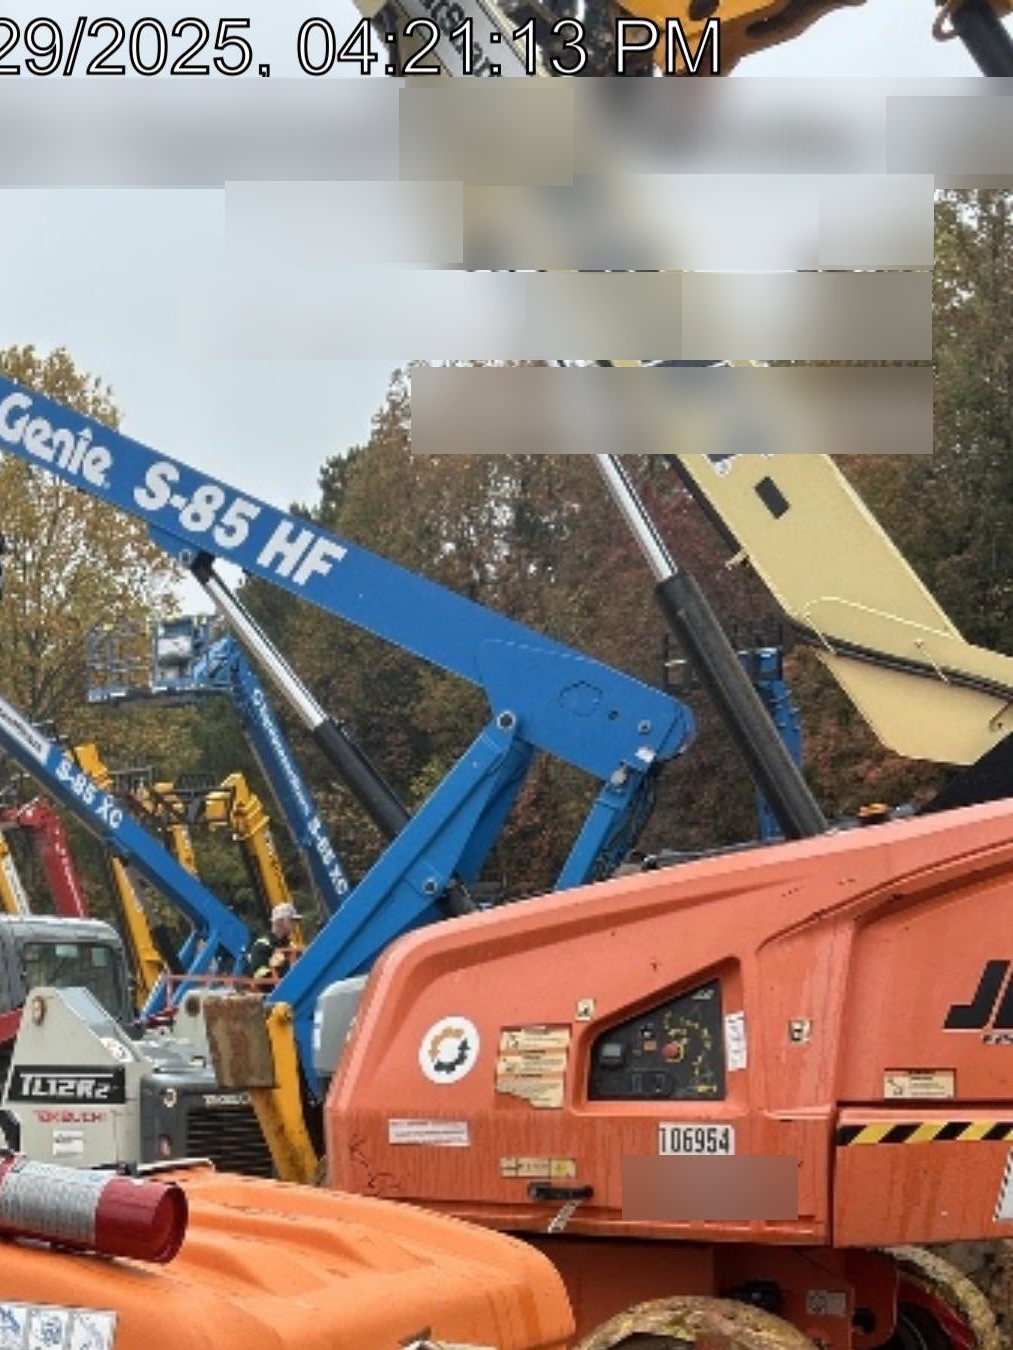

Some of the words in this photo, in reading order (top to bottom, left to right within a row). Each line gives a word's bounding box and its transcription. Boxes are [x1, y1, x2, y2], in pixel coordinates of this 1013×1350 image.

[133, 461, 261, 549] S-85
[256, 519, 348, 586] HF
[659, 1127, 730, 1153] 106954
